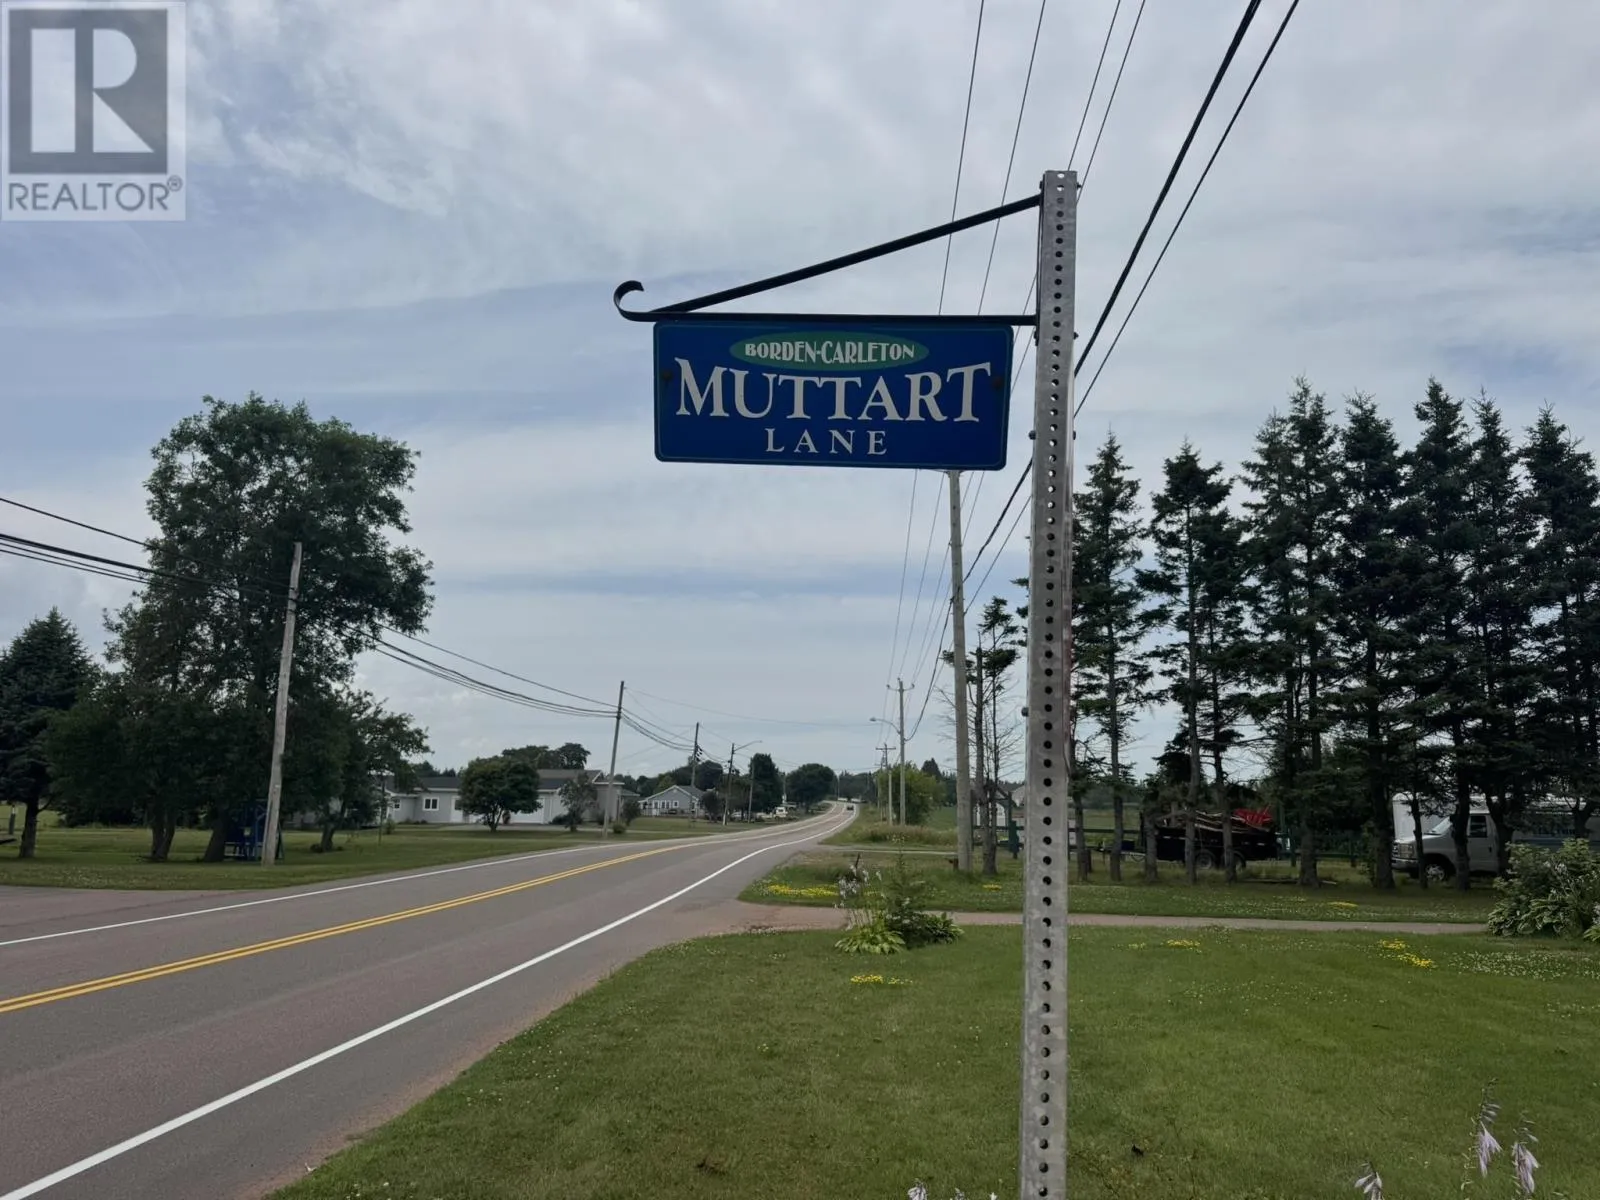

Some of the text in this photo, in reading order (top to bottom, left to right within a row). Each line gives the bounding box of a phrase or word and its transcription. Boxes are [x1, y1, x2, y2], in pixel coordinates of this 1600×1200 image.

[745, 341, 915, 364] BORDEN-CARLETON
[674, 357, 991, 422] MUTTART
[765, 428, 887, 455] LANE
